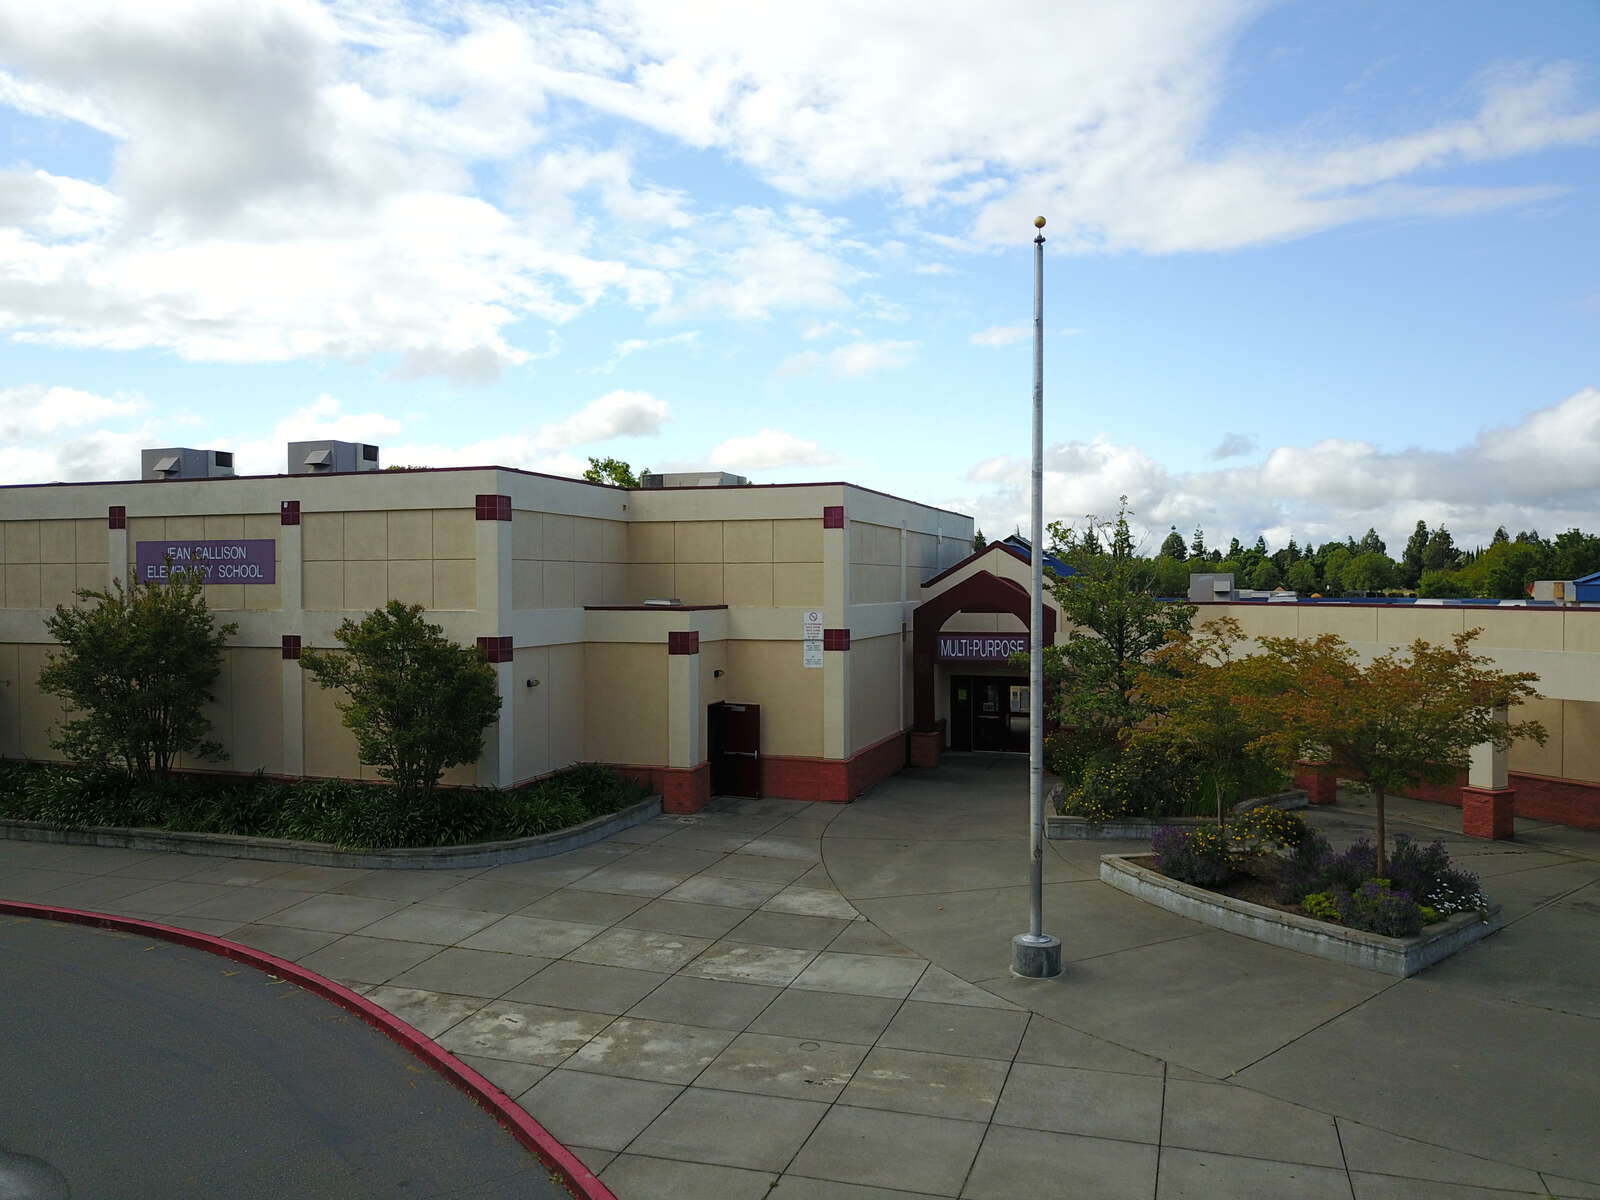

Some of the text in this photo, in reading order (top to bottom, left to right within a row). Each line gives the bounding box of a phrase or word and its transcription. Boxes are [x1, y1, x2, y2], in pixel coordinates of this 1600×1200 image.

[195, 546, 247, 560] CALLISON
[218, 564, 264, 578] SCHOOL
[941, 639, 1025, 657] MULTI-PURPOSE
